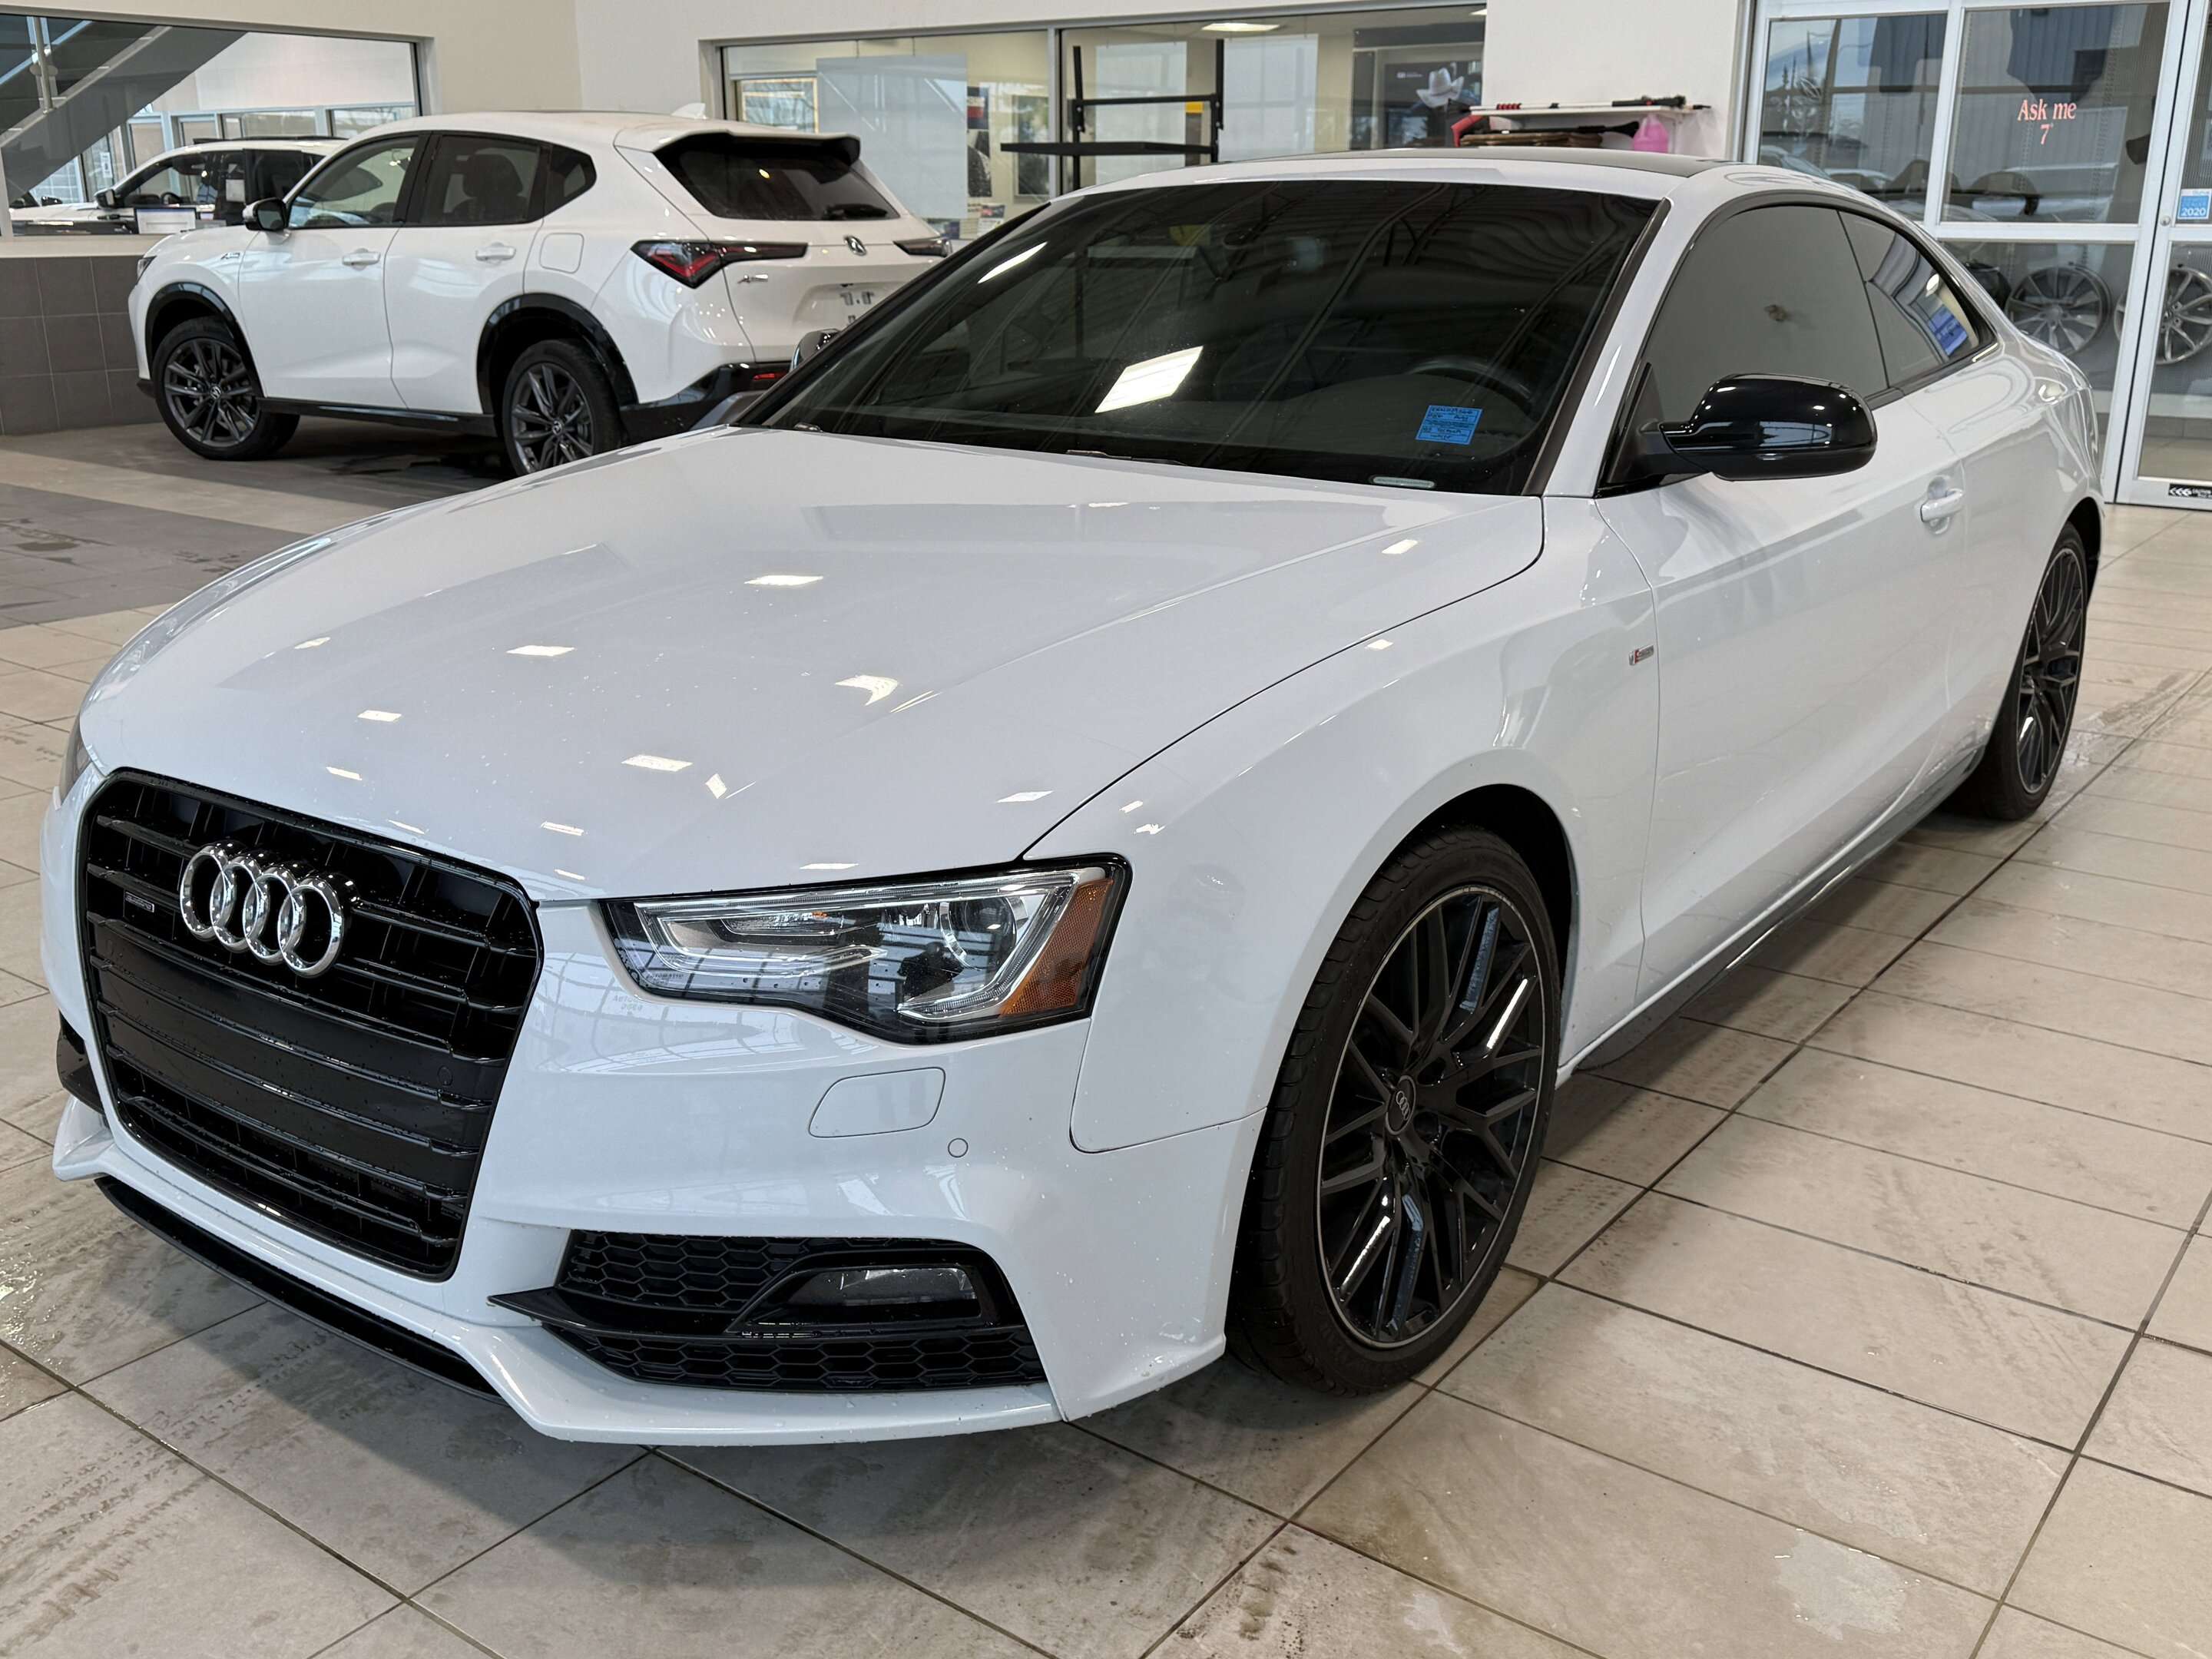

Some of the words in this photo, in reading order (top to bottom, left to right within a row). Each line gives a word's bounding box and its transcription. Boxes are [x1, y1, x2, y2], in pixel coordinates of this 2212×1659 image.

[2017, 98, 2048, 121] Ask
[2052, 102, 2077, 120] me
[2181, 207, 2207, 217] 2020
